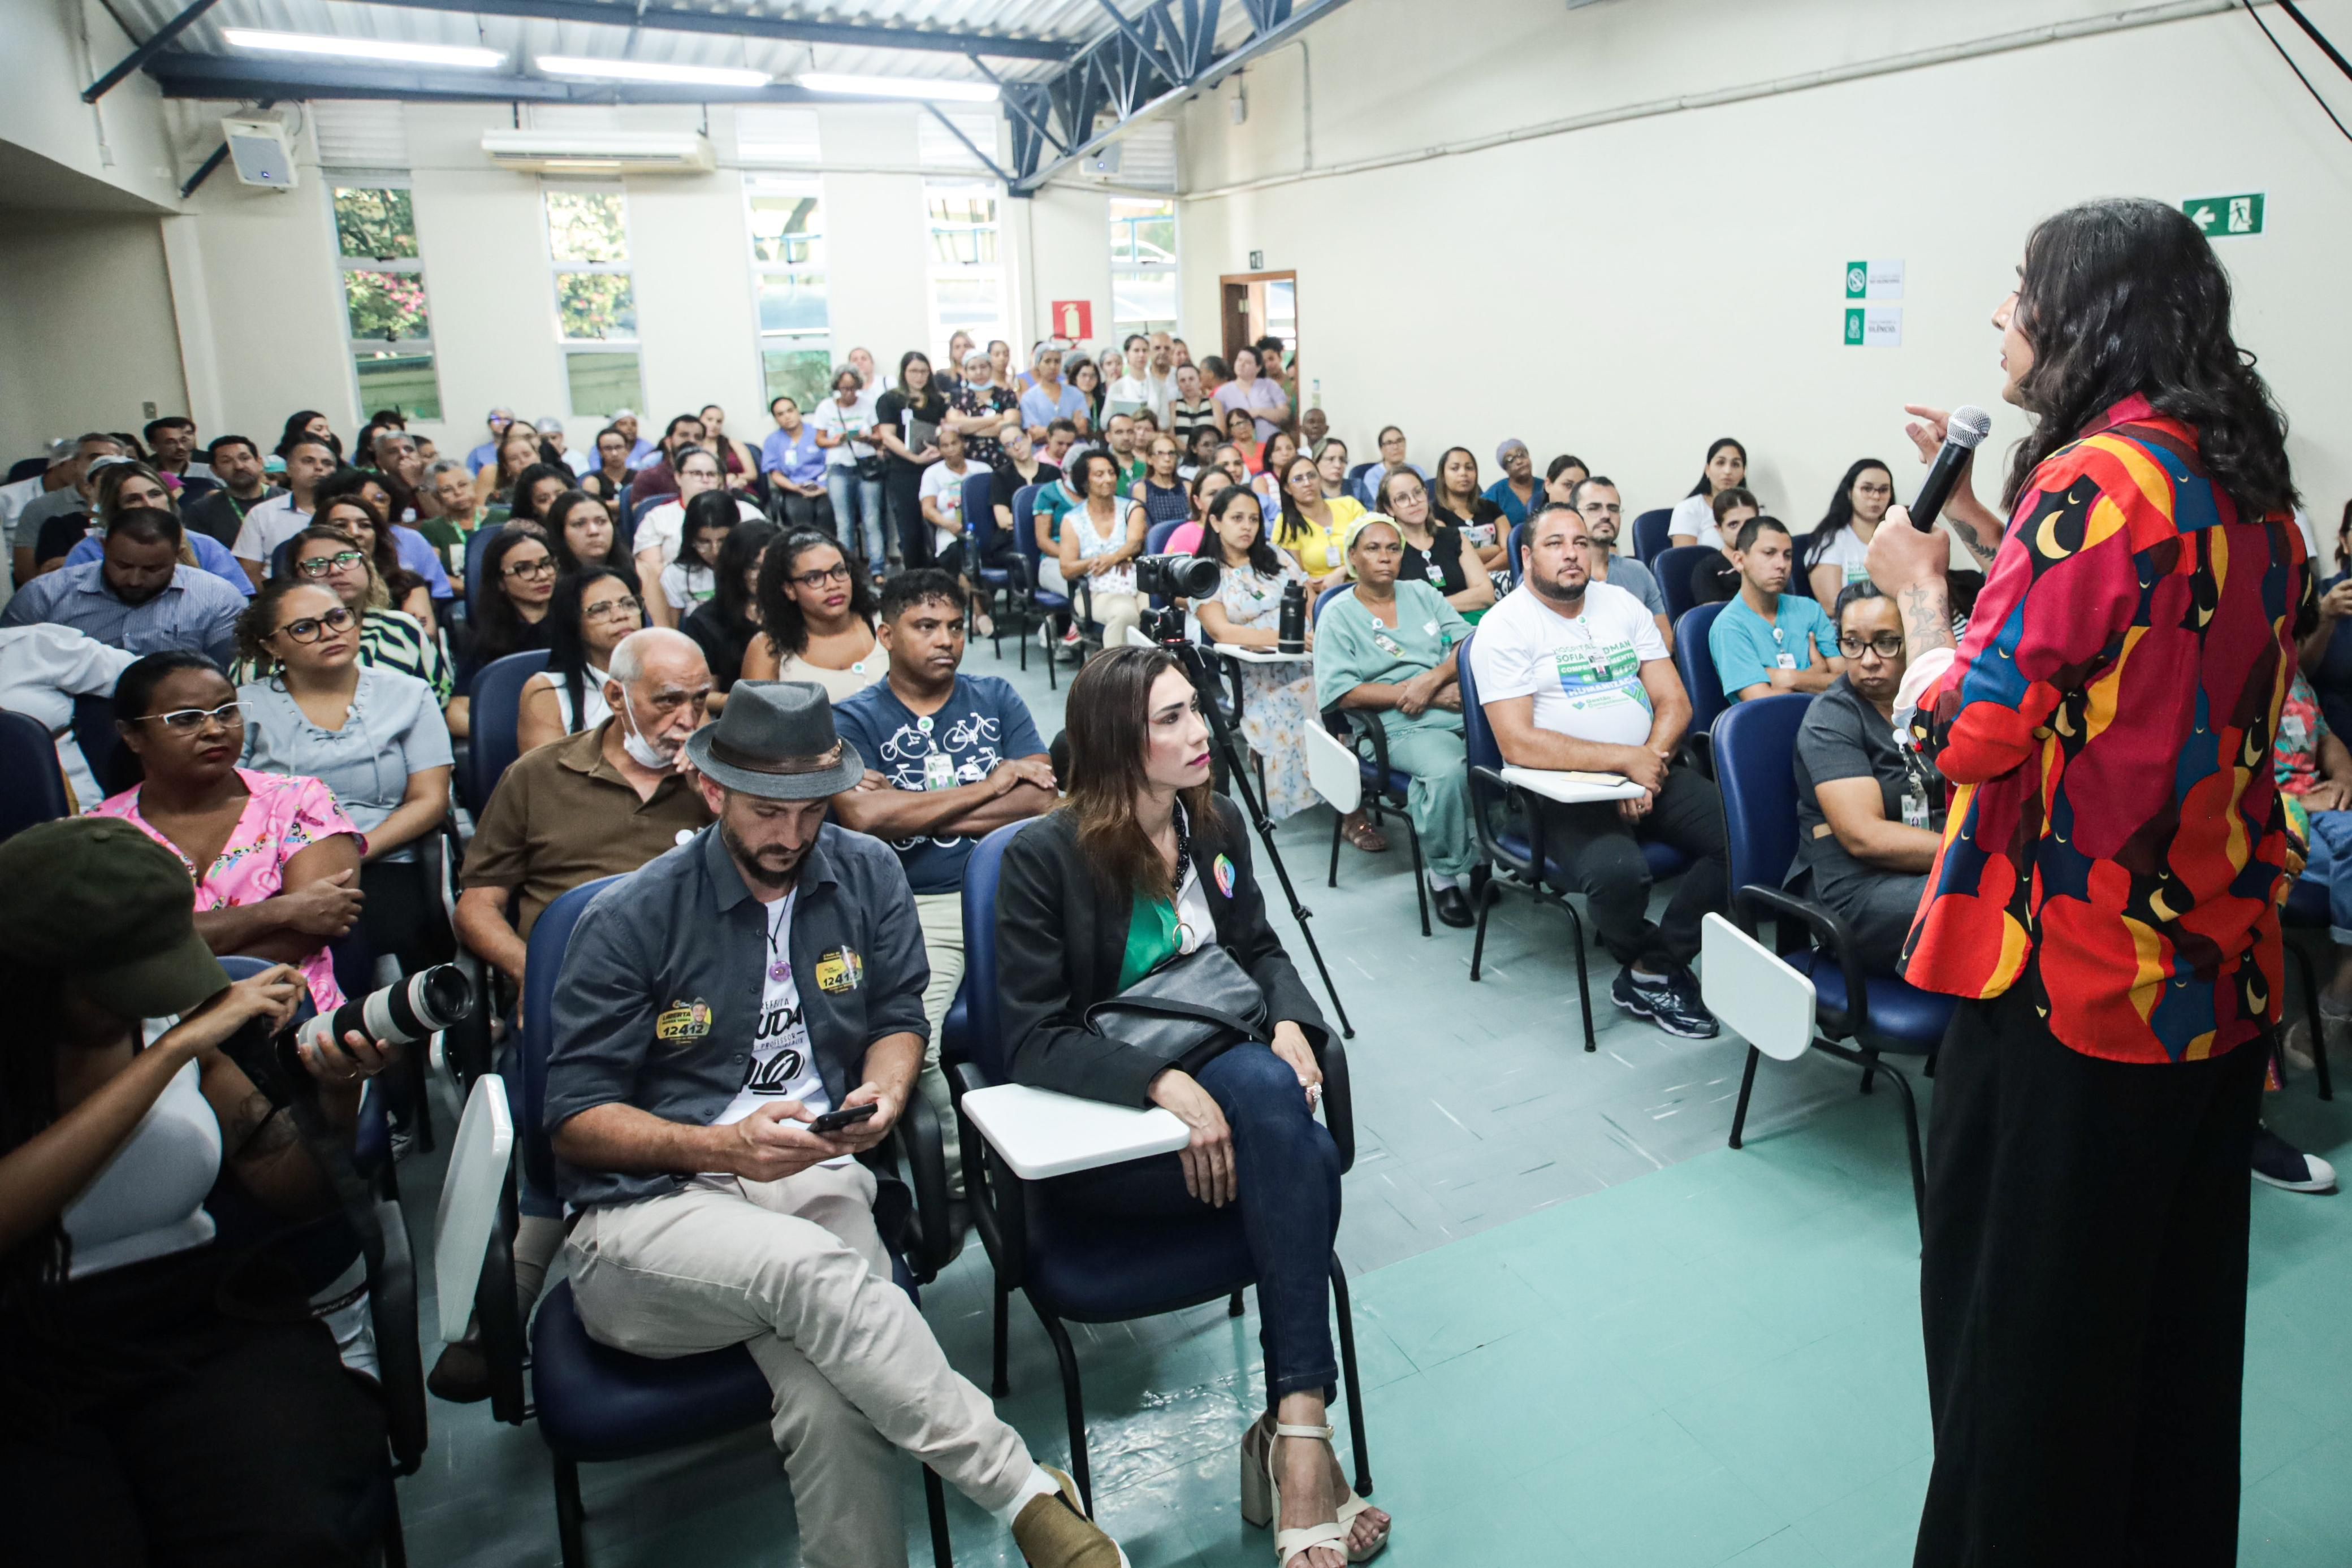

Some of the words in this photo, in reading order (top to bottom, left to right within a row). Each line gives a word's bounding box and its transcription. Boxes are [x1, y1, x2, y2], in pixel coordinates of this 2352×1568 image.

[1553, 643, 1597, 654] HOSPITAL
[1556, 653, 1585, 663] SOFIA
[1602, 640, 1631, 655] DMAN
[663, 1024, 704, 1036] 12412
[755, 1004, 802, 1040] UDA
